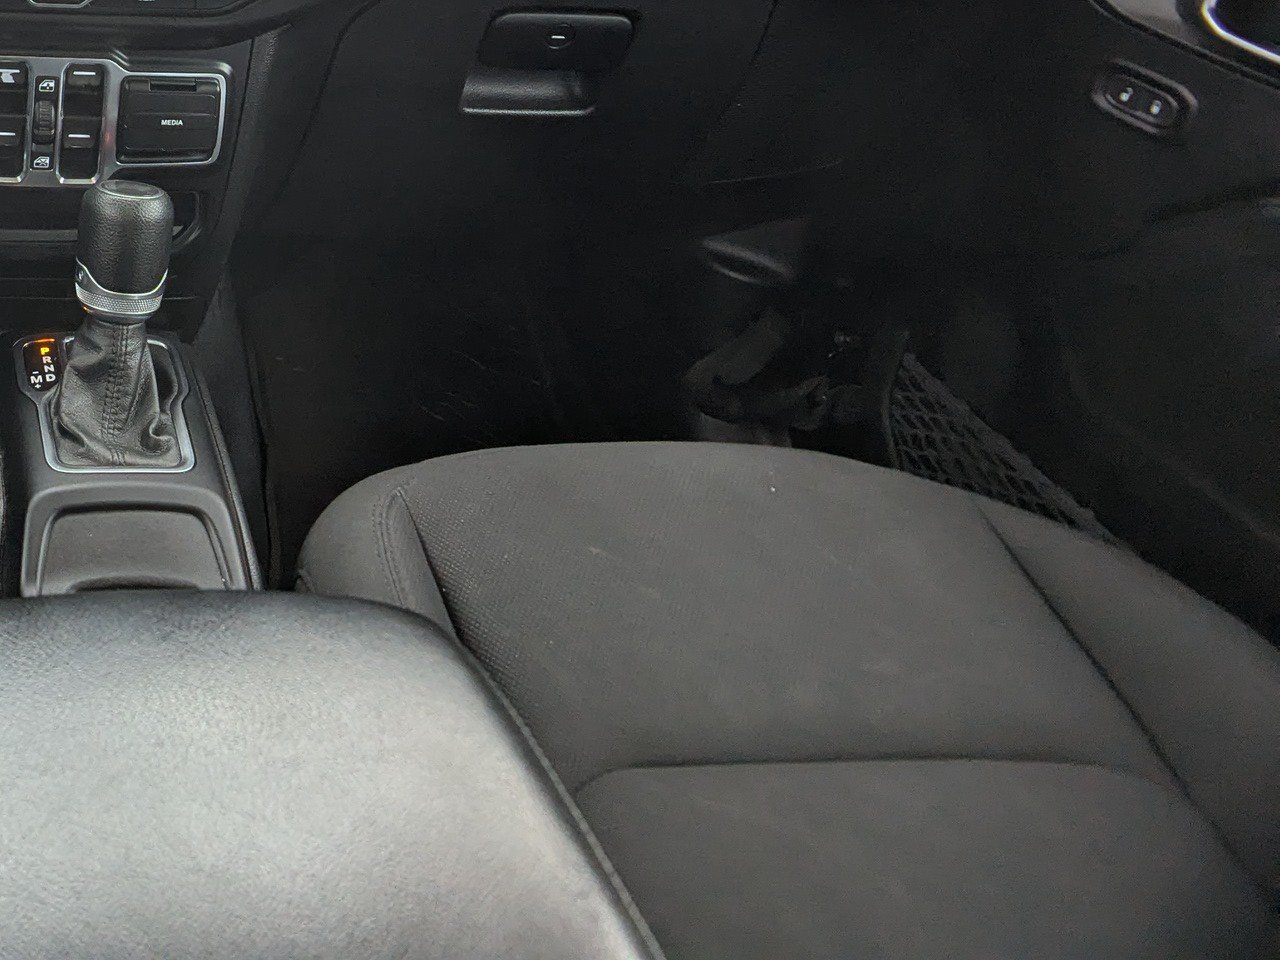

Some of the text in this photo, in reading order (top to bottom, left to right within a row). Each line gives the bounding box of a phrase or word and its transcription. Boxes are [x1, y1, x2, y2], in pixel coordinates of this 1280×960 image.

[40, 347, 50, 356] P
[42, 355, 52, 364] R
[43, 364, 55, 373] N
[30, 375, 43, 384] M
[45, 373, 56, 382] D
